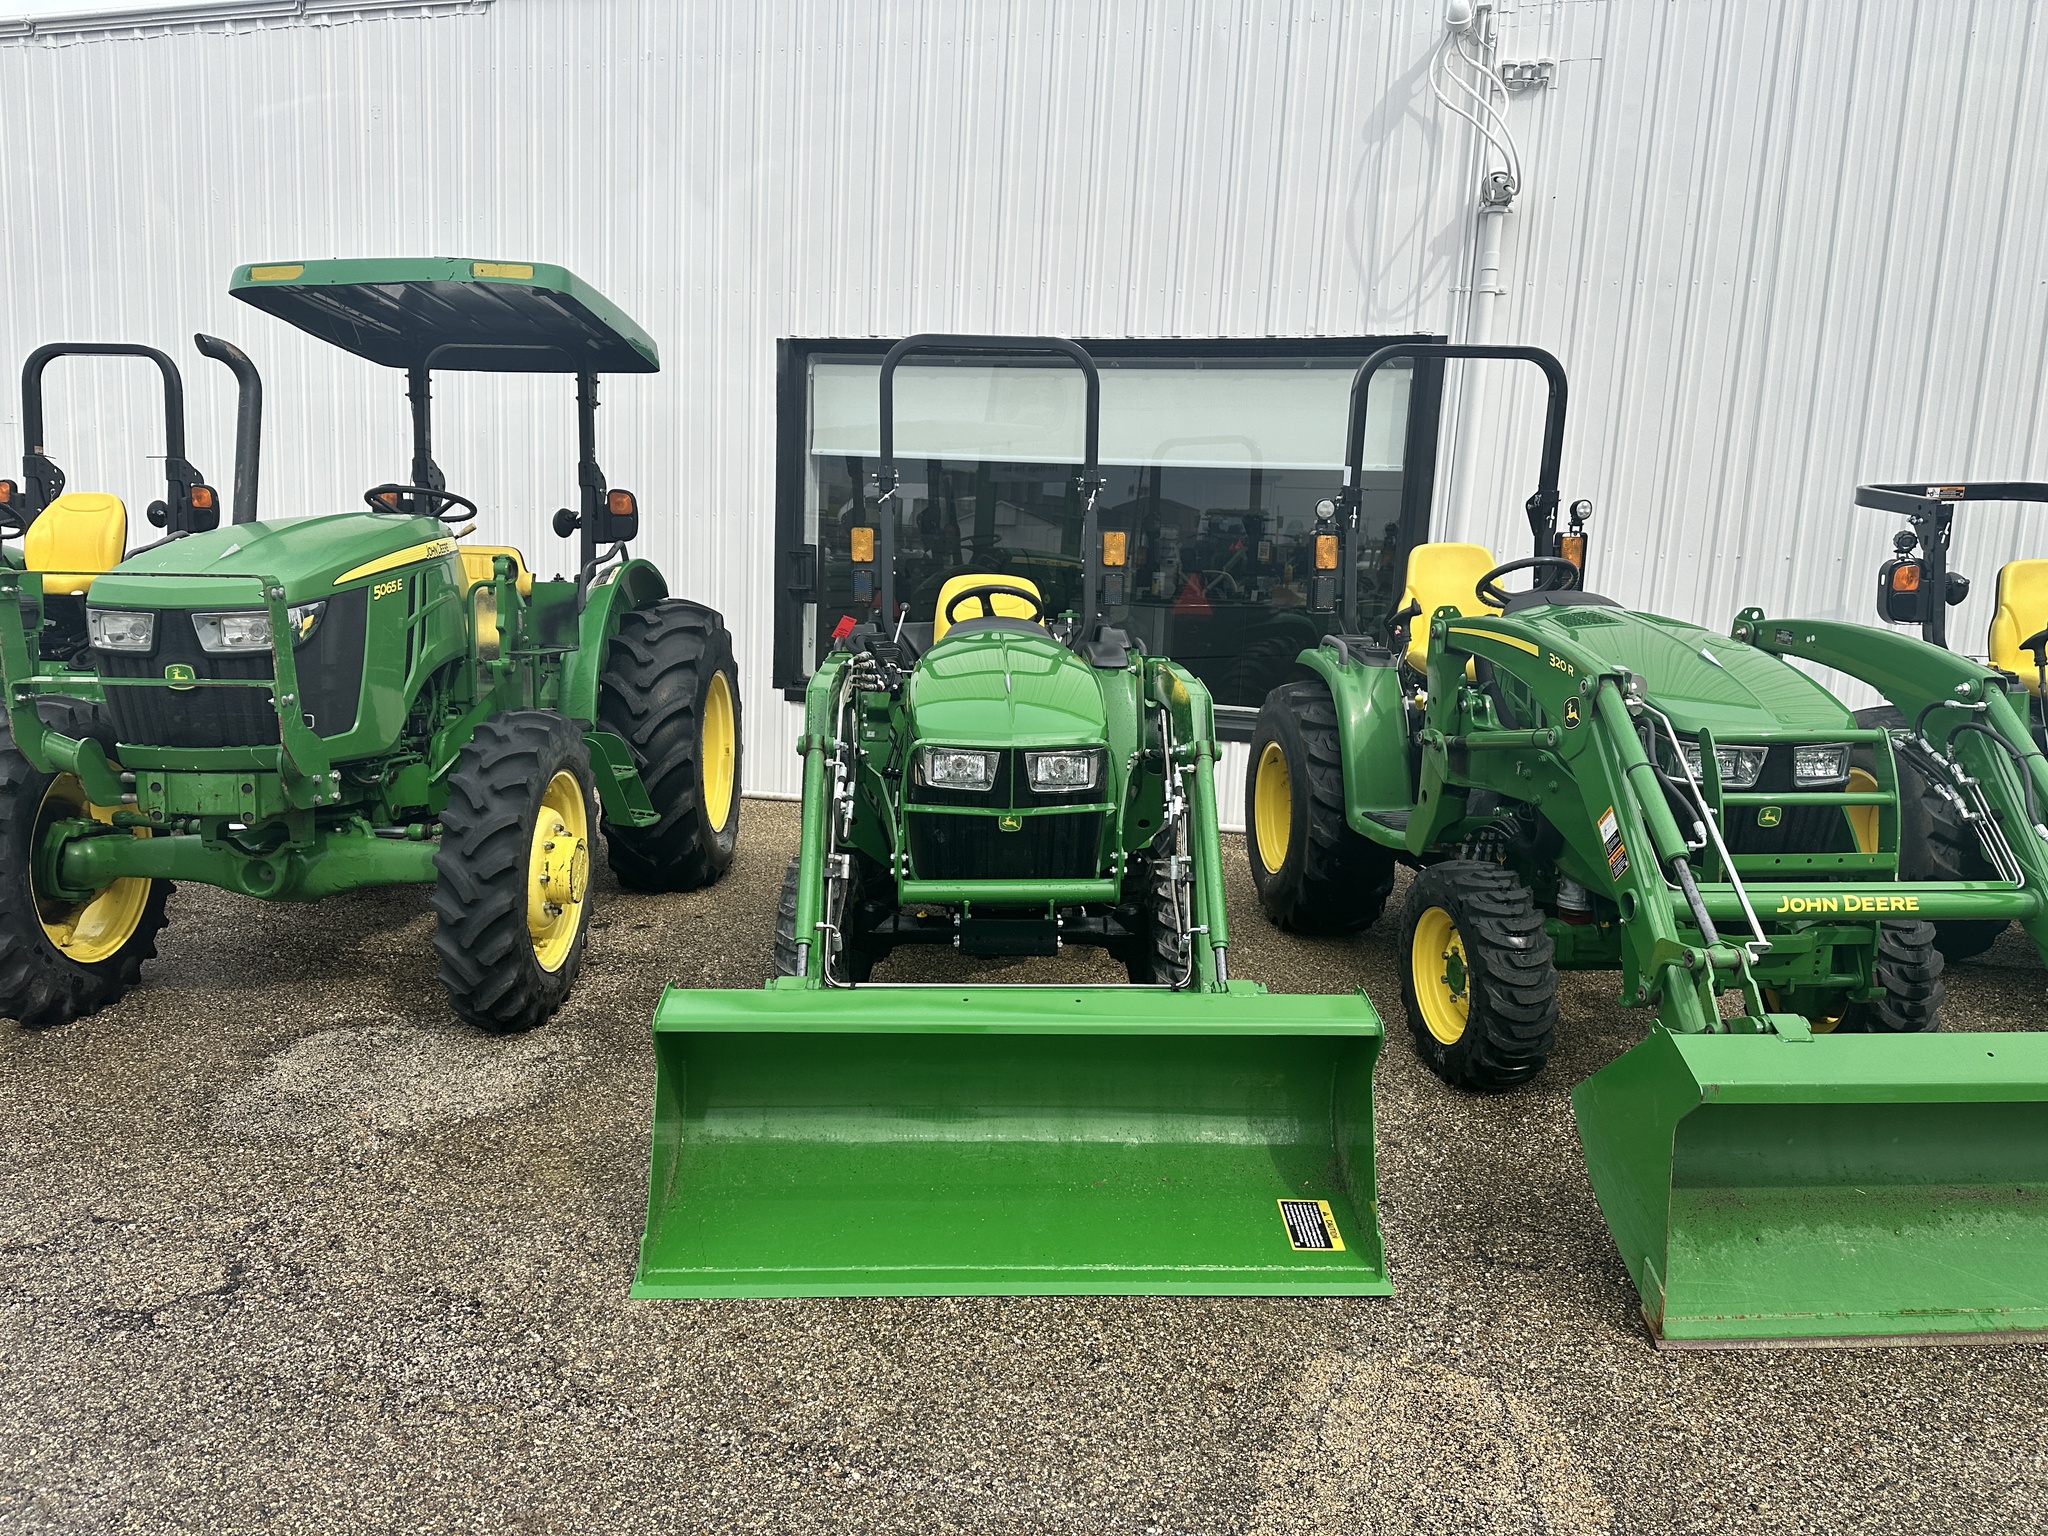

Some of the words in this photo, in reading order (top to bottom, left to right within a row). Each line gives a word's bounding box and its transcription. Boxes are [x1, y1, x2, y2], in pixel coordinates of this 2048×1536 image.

[425, 544, 438, 558] JOHN
[1776, 895, 1838, 913] JOHN
[1842, 894, 1920, 912] DEERE
